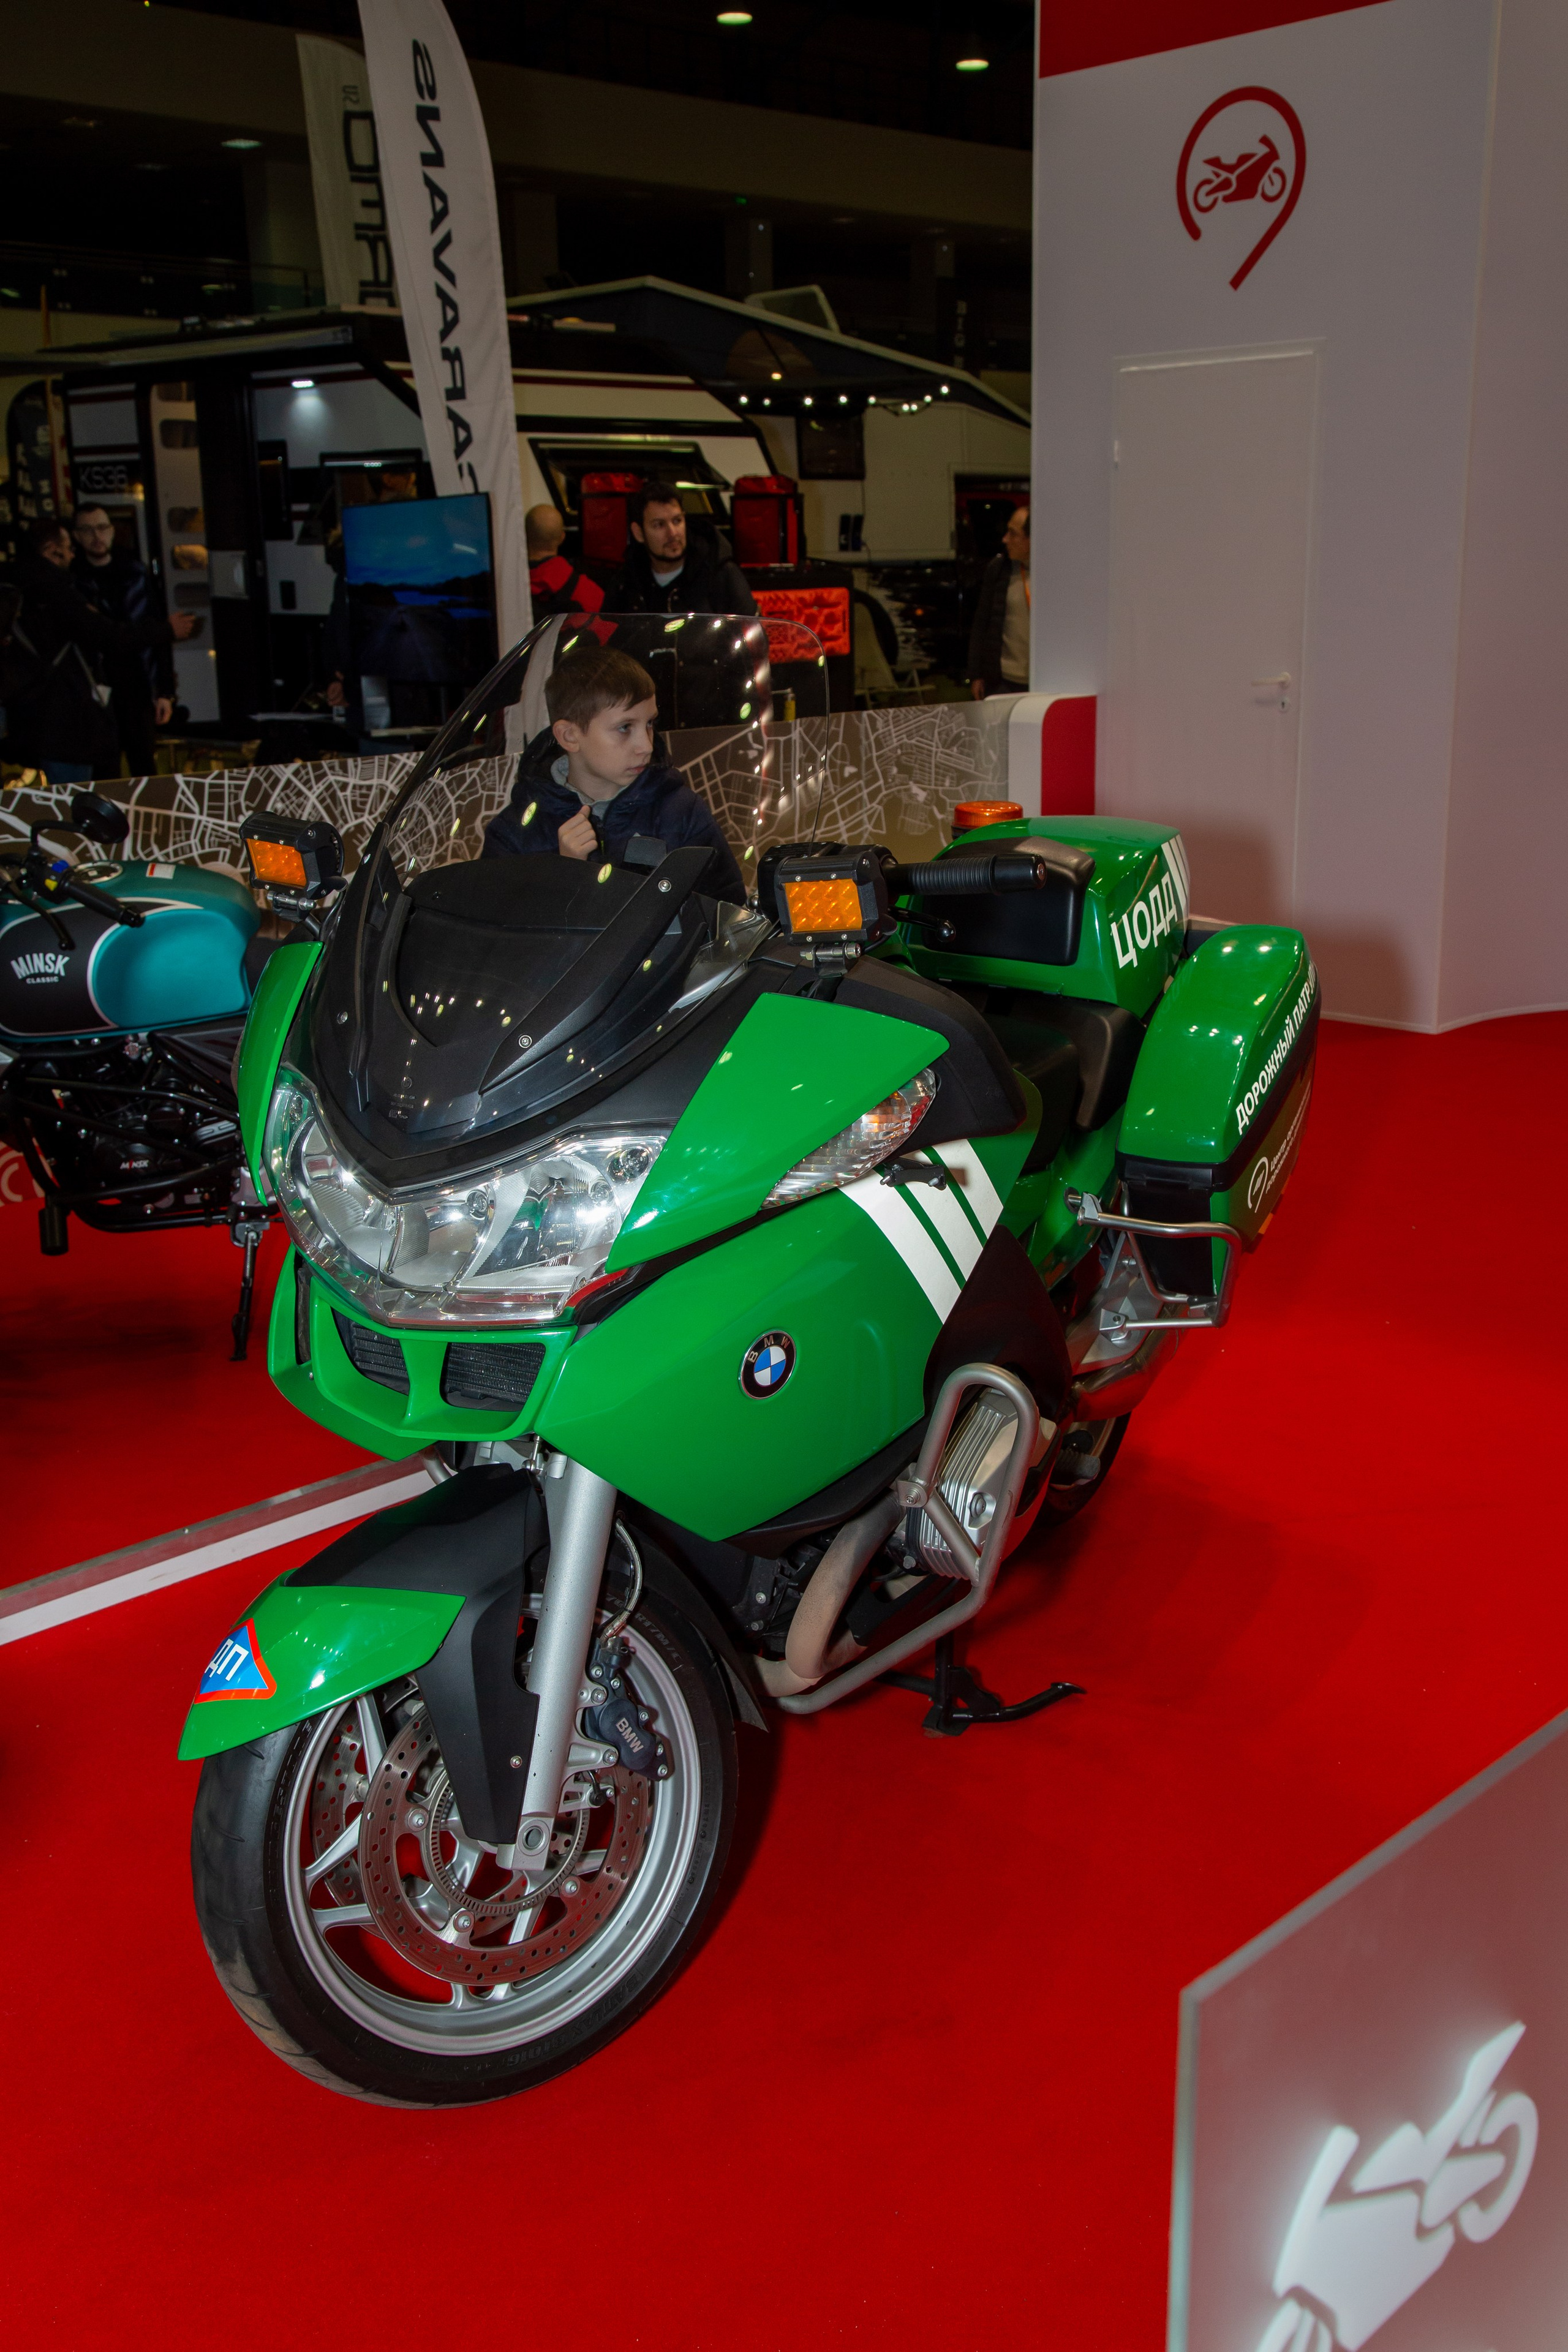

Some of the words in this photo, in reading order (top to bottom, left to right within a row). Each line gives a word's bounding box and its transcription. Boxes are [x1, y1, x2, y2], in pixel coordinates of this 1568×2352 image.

[1110, 871, 1178, 969] ЦОДД
[10, 952, 70, 979] MINSK
[1235, 1015, 1295, 1136] ДОРОЖНЫЙ
[748, 1335, 790, 1363] BMW
[204, 1638, 249, 1681] ДП
[615, 1717, 644, 1754] BMW
